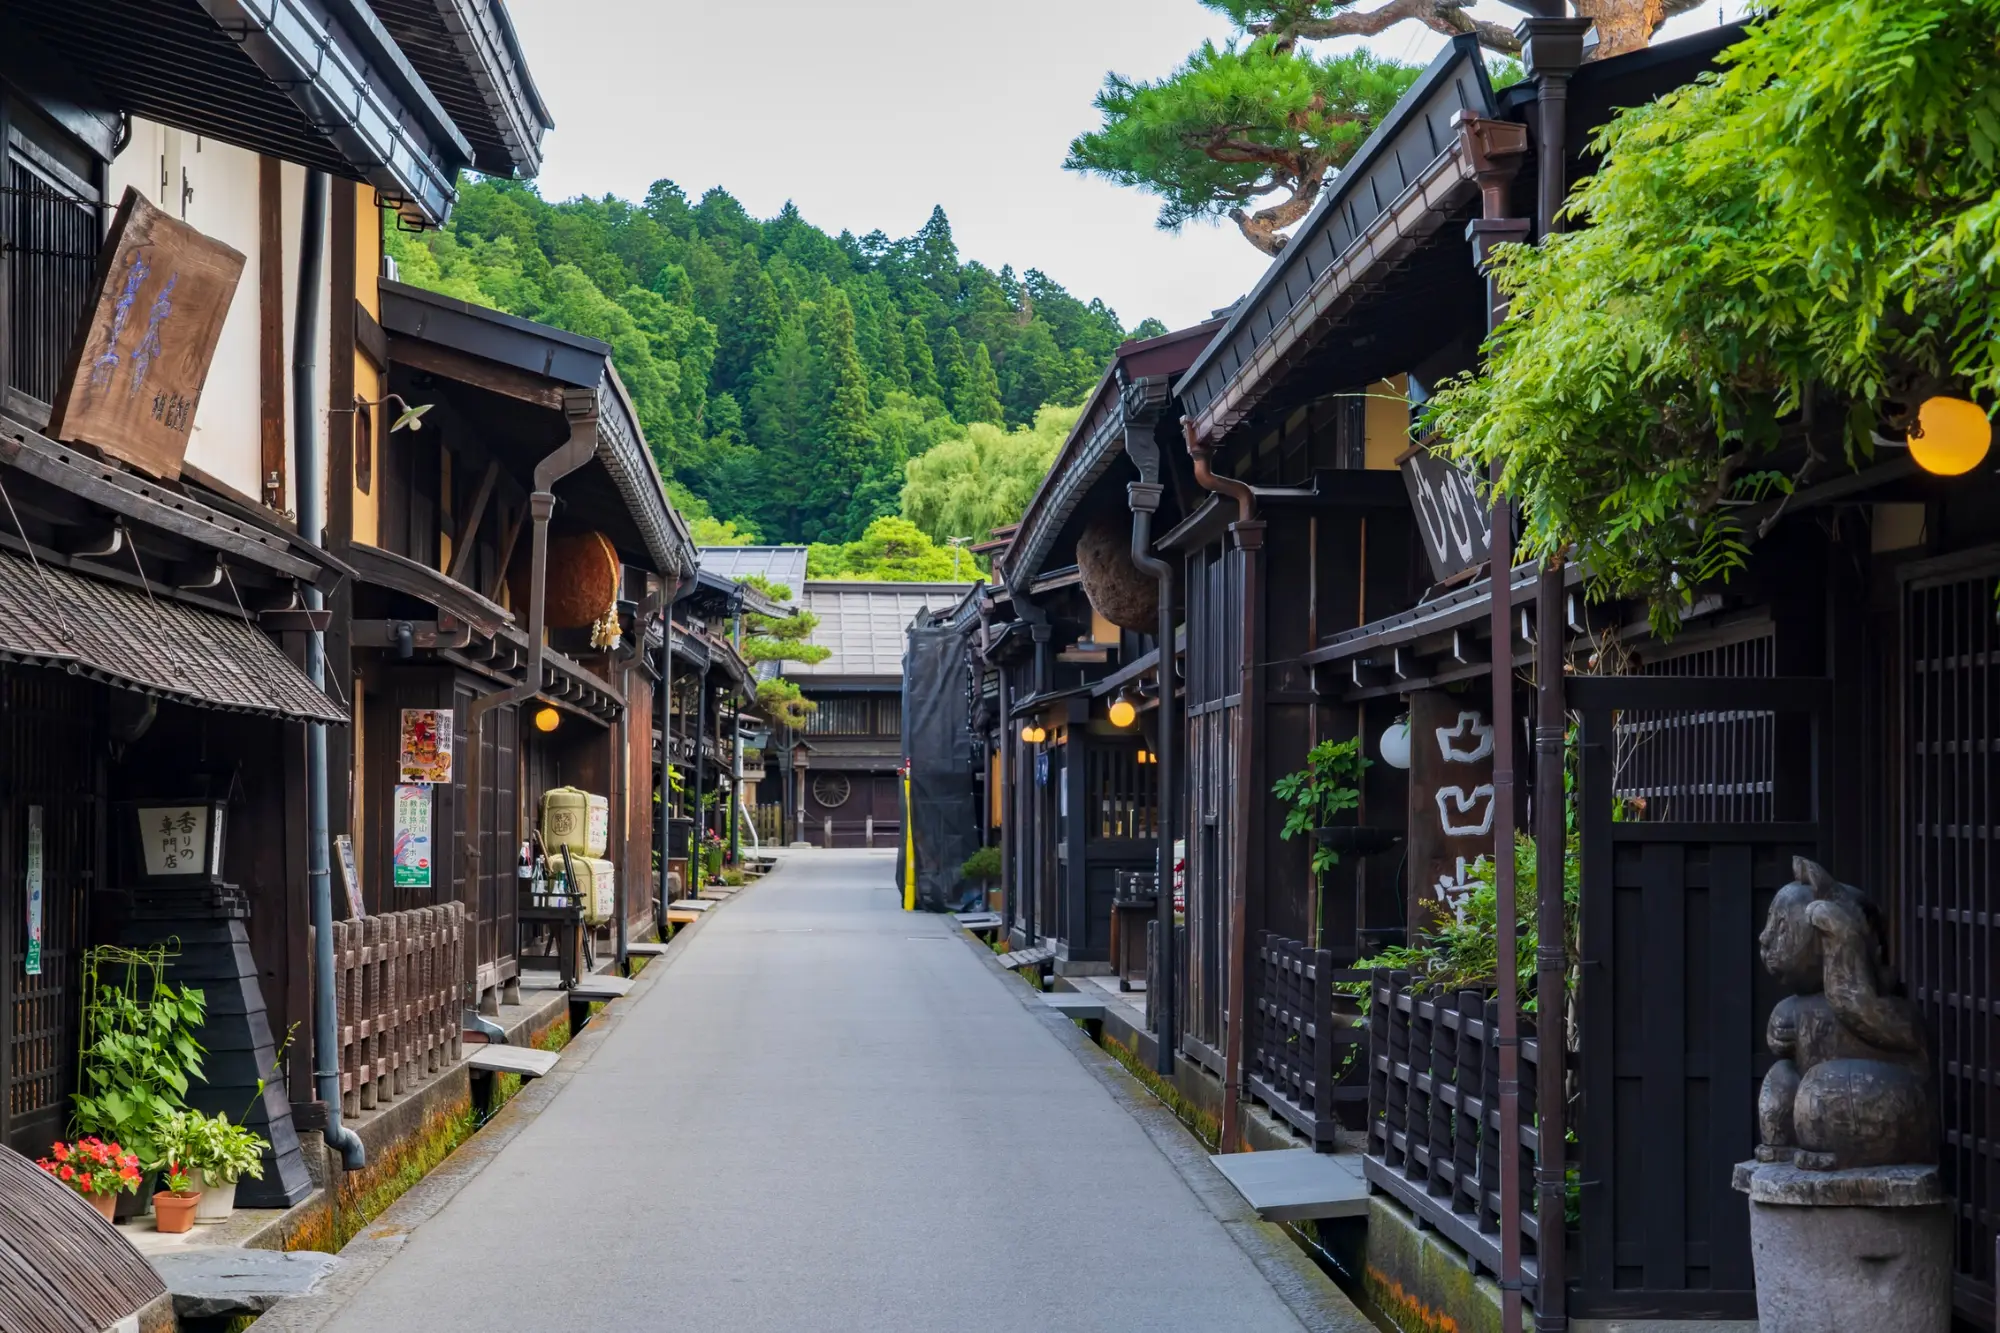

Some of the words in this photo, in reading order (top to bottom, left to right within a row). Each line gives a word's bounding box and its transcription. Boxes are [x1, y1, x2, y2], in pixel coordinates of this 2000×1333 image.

[159, 815, 178, 869] 専門店
[176, 811, 196, 860] 香りの
